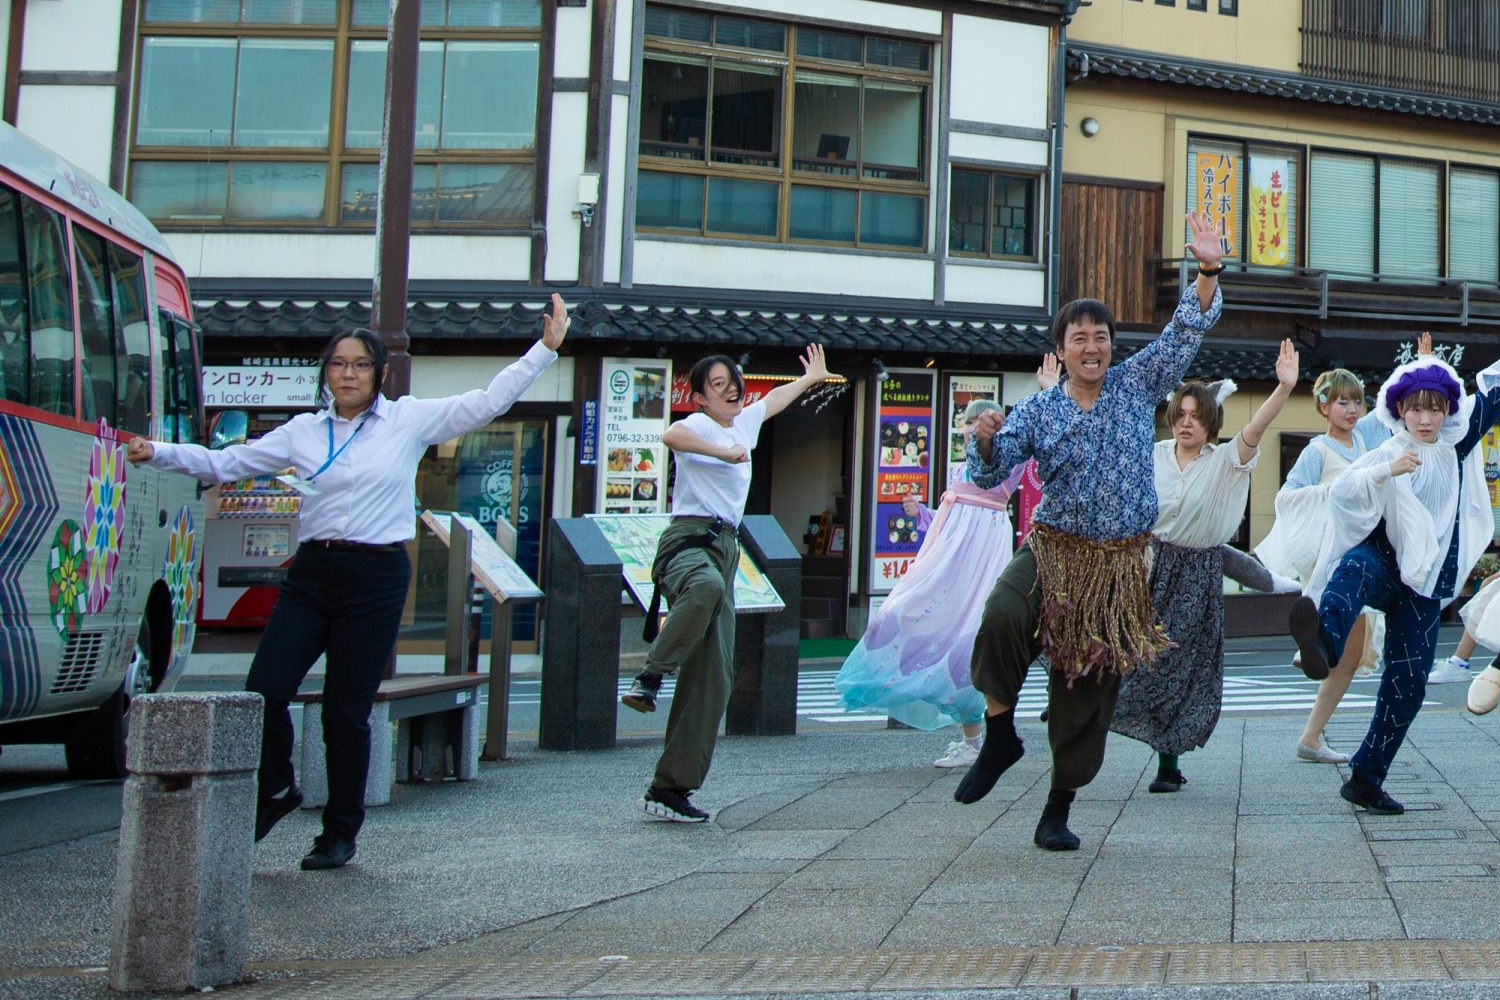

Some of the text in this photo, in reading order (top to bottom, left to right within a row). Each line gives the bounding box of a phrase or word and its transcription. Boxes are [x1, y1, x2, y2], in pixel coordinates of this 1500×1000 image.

[1203, 168, 1214, 232] 冷えて
[1218, 155, 1232, 256] ハイボール
[1271, 170, 1282, 247] 生ビール
[1258, 194, 1267, 254] 冷えてます
[1393, 341, 1465, 367] 海茶屋
[295, 375, 306, 384] 小
[221, 391, 267, 404] locker
[607, 423, 621, 431] TEL
[882, 559, 915, 579] ¥1,4
